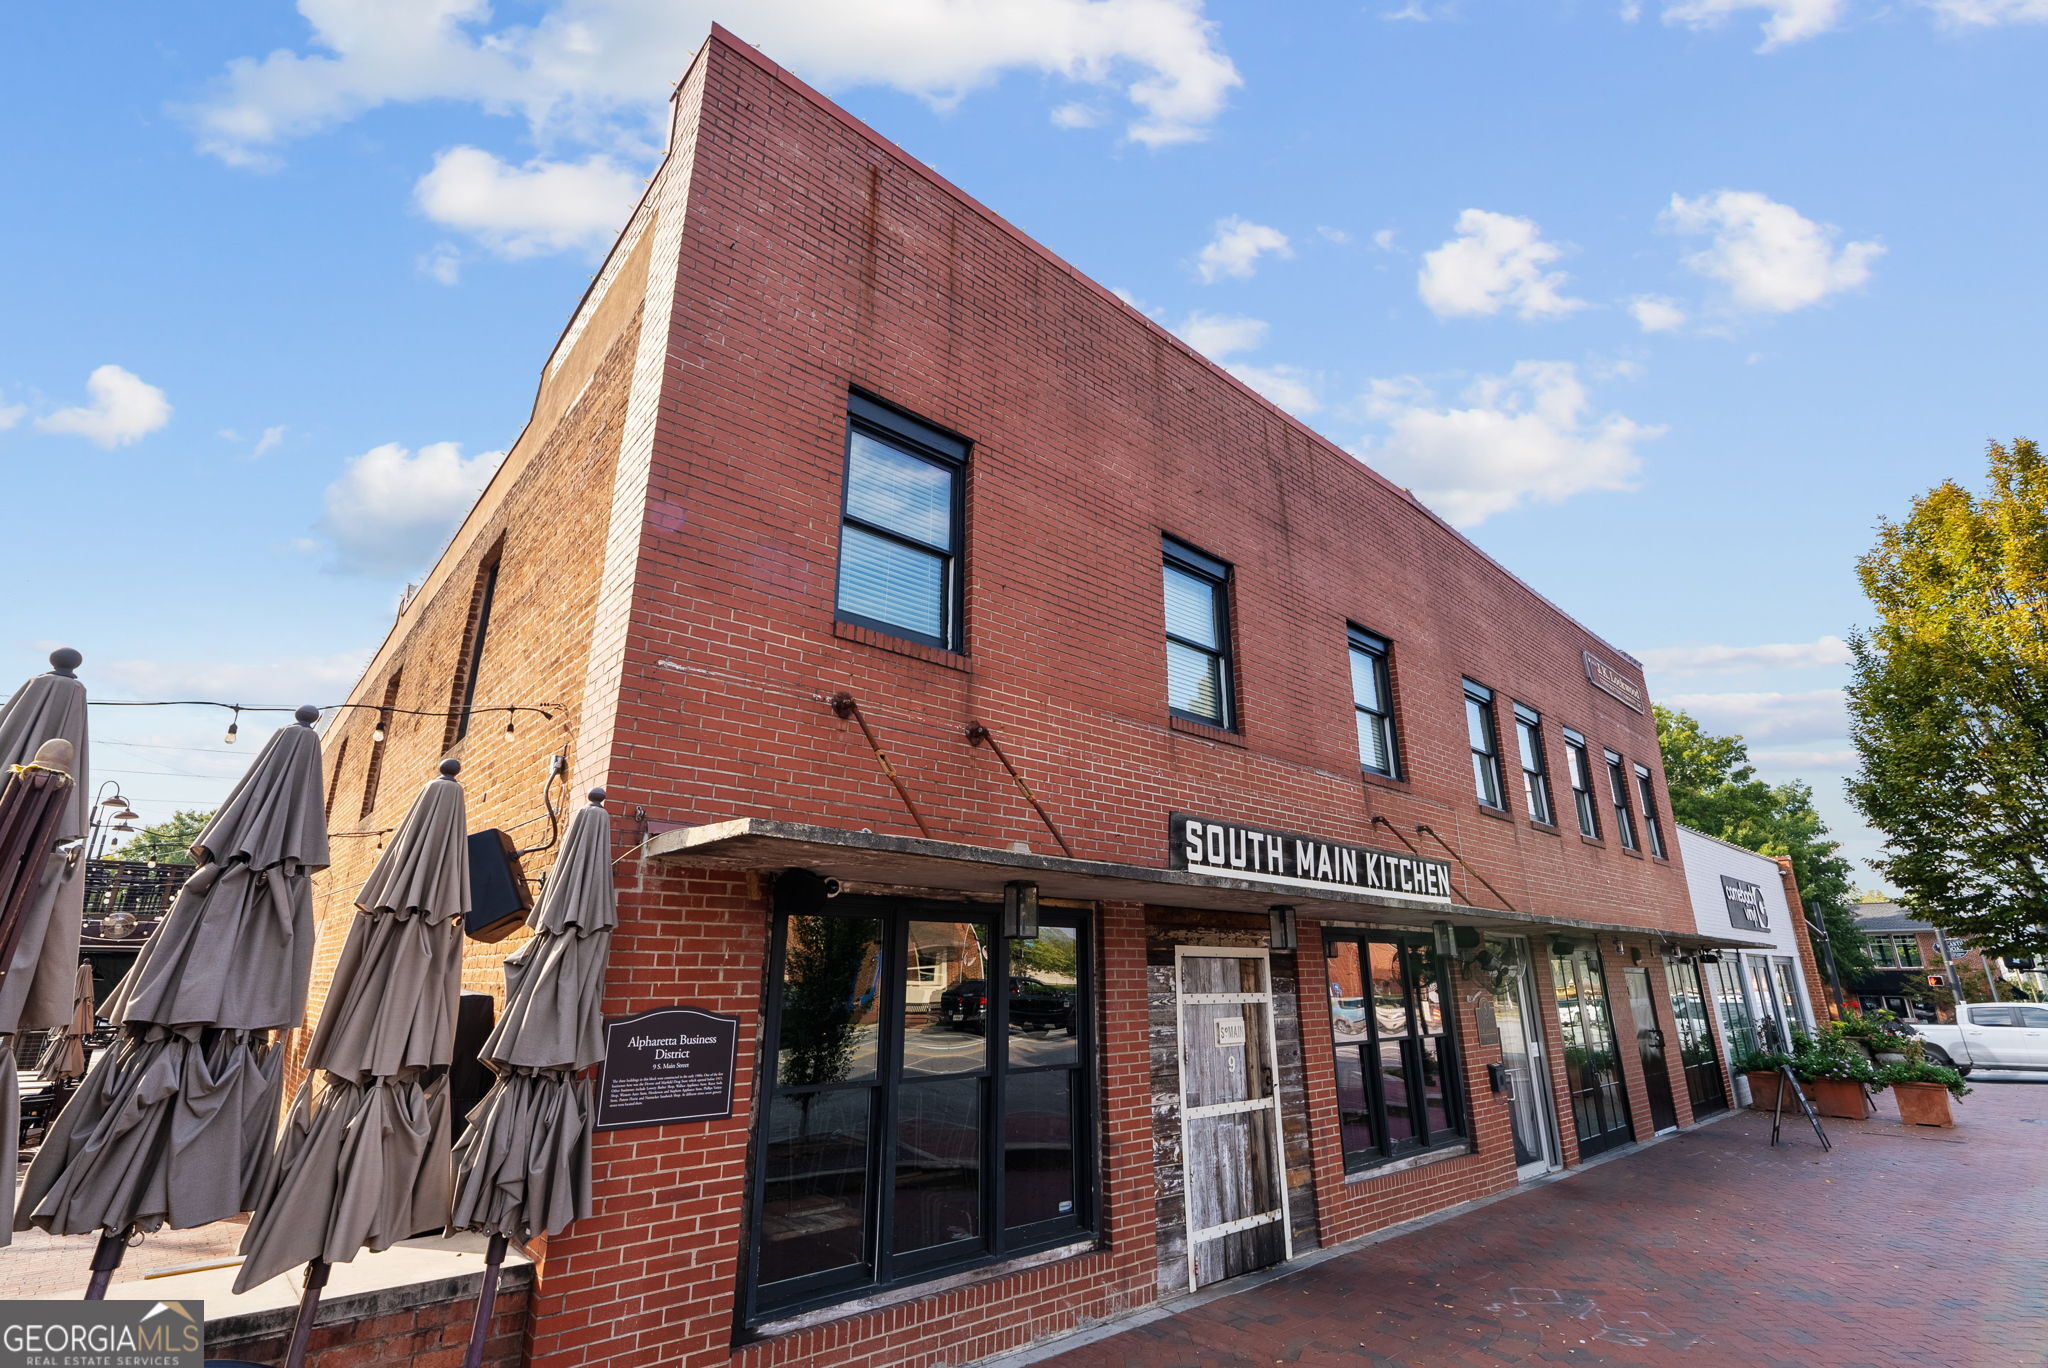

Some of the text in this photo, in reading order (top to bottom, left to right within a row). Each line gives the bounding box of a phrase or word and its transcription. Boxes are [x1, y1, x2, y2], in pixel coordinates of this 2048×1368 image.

[1185, 820, 1451, 896] SOUTH MAIN KITCHEN
[627, 1034, 717, 1050] Alpharetta Business
[654, 1048, 690, 1060] District
[1228, 1055, 1236, 1073] 9
